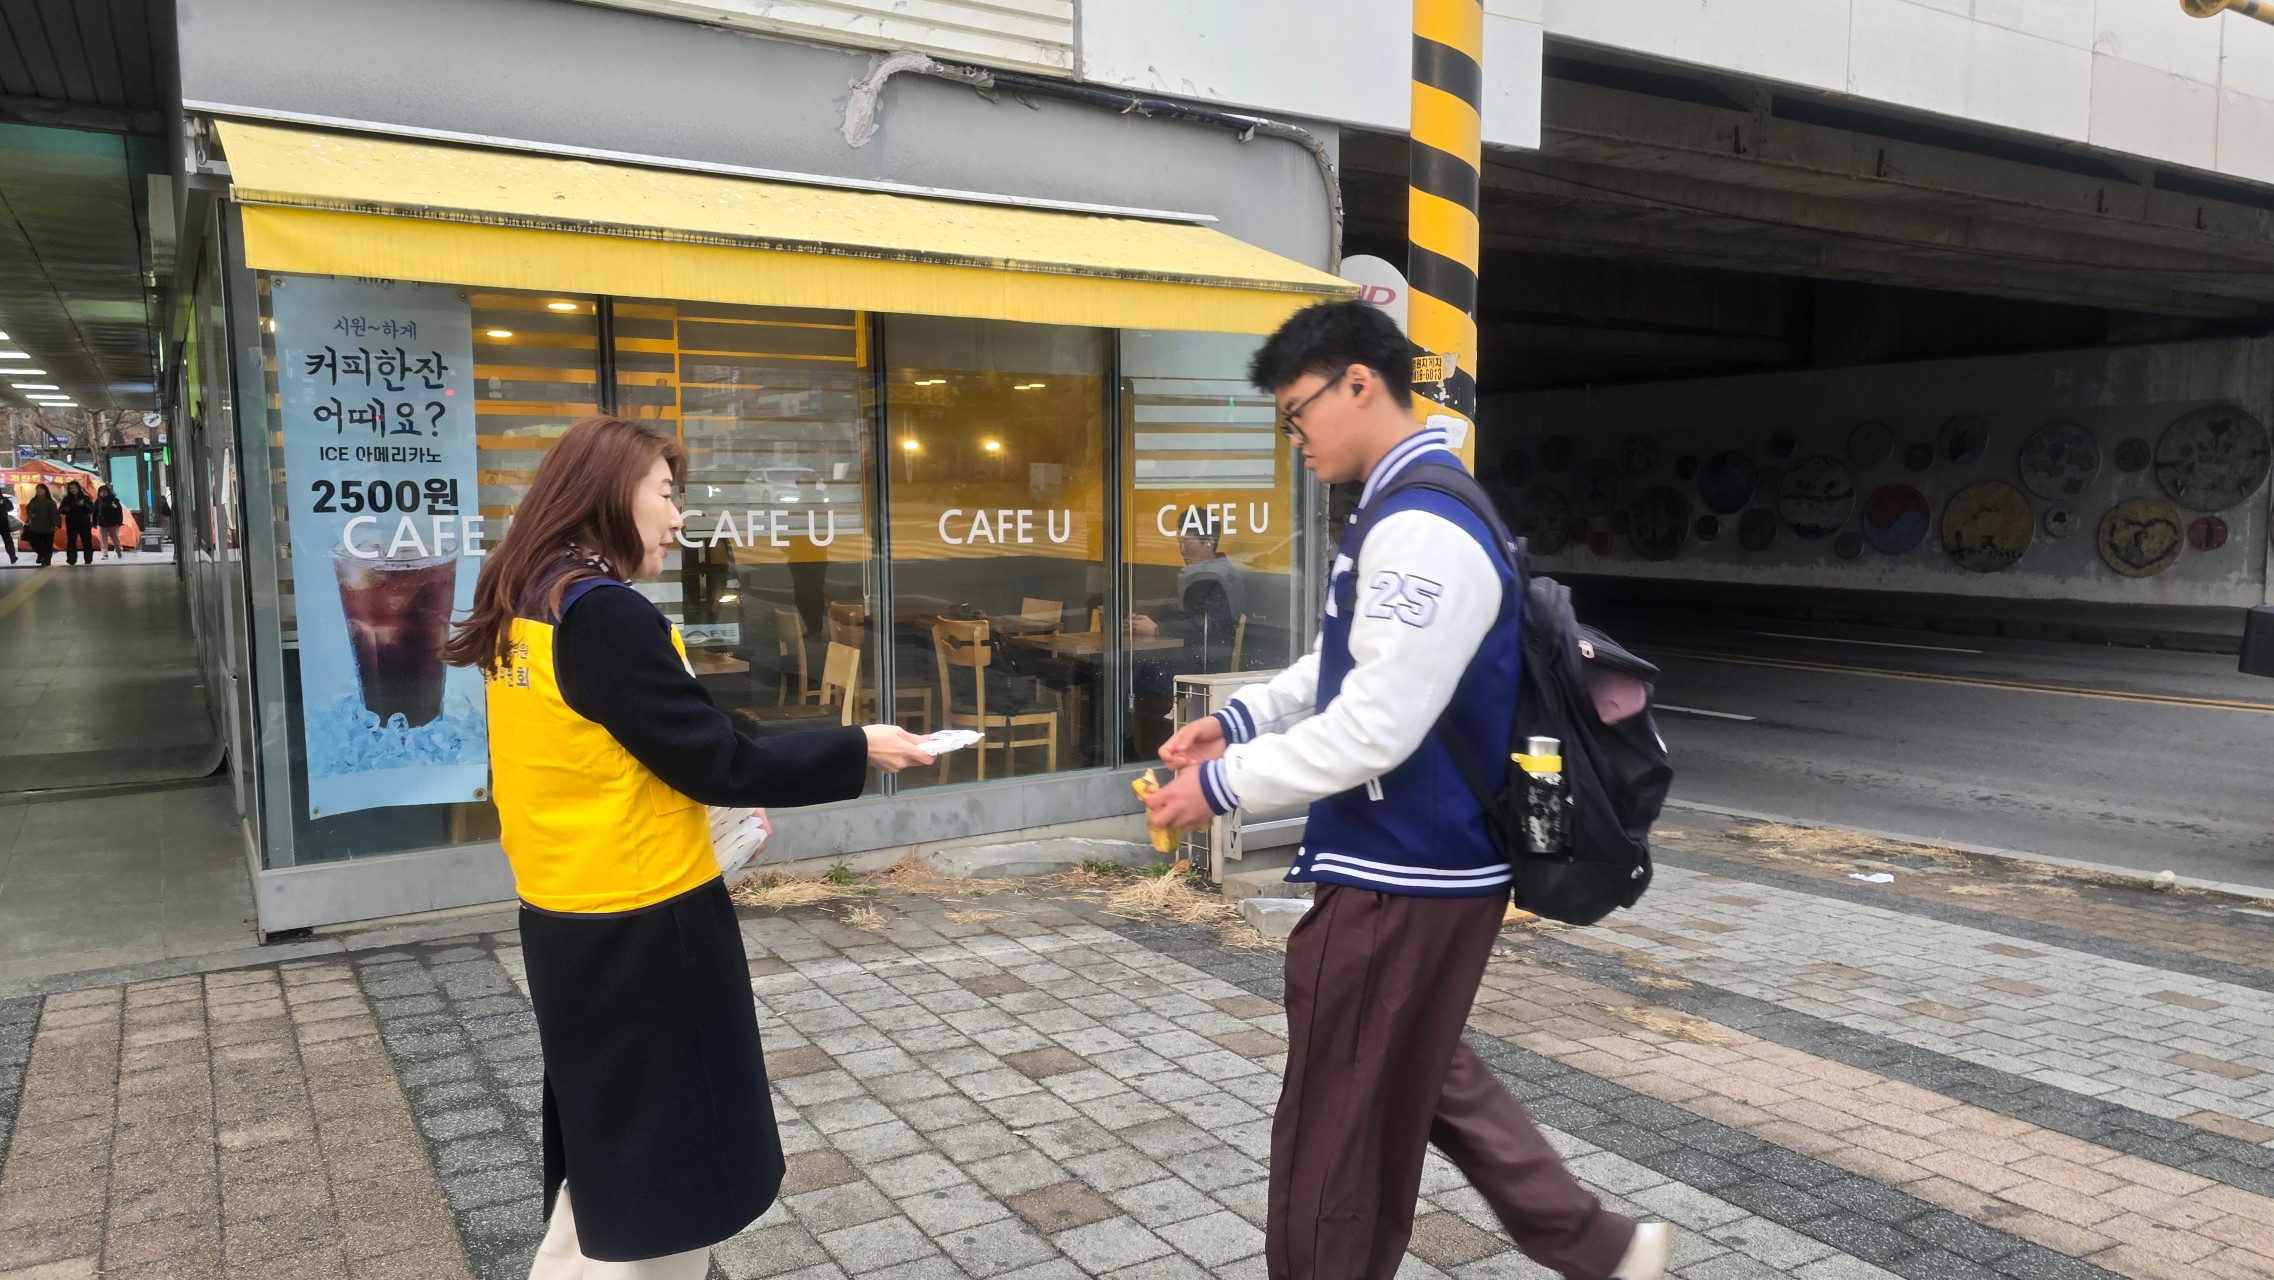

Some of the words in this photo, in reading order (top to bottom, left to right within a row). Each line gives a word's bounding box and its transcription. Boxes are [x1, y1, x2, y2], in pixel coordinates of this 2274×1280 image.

[333, 316, 417, 341] 시원~하게
[305, 345, 449, 392] 커피한잔
[313, 397, 446, 438] 어때요?
[319, 446, 349, 461] ICE
[355, 446, 442, 463] 아메리카노
[311, 478, 459, 516] 2500원
[343, 515, 487, 559] CAFE
[674, 509, 790, 547] CAFE
[808, 510, 834, 547] U
[938, 509, 1033, 544] CAFE
[1048, 509, 1070, 543] U
[1156, 503, 1237, 537] CAFE
[1249, 502, 1269, 534] U
[1365, 570, 1443, 629] 25
